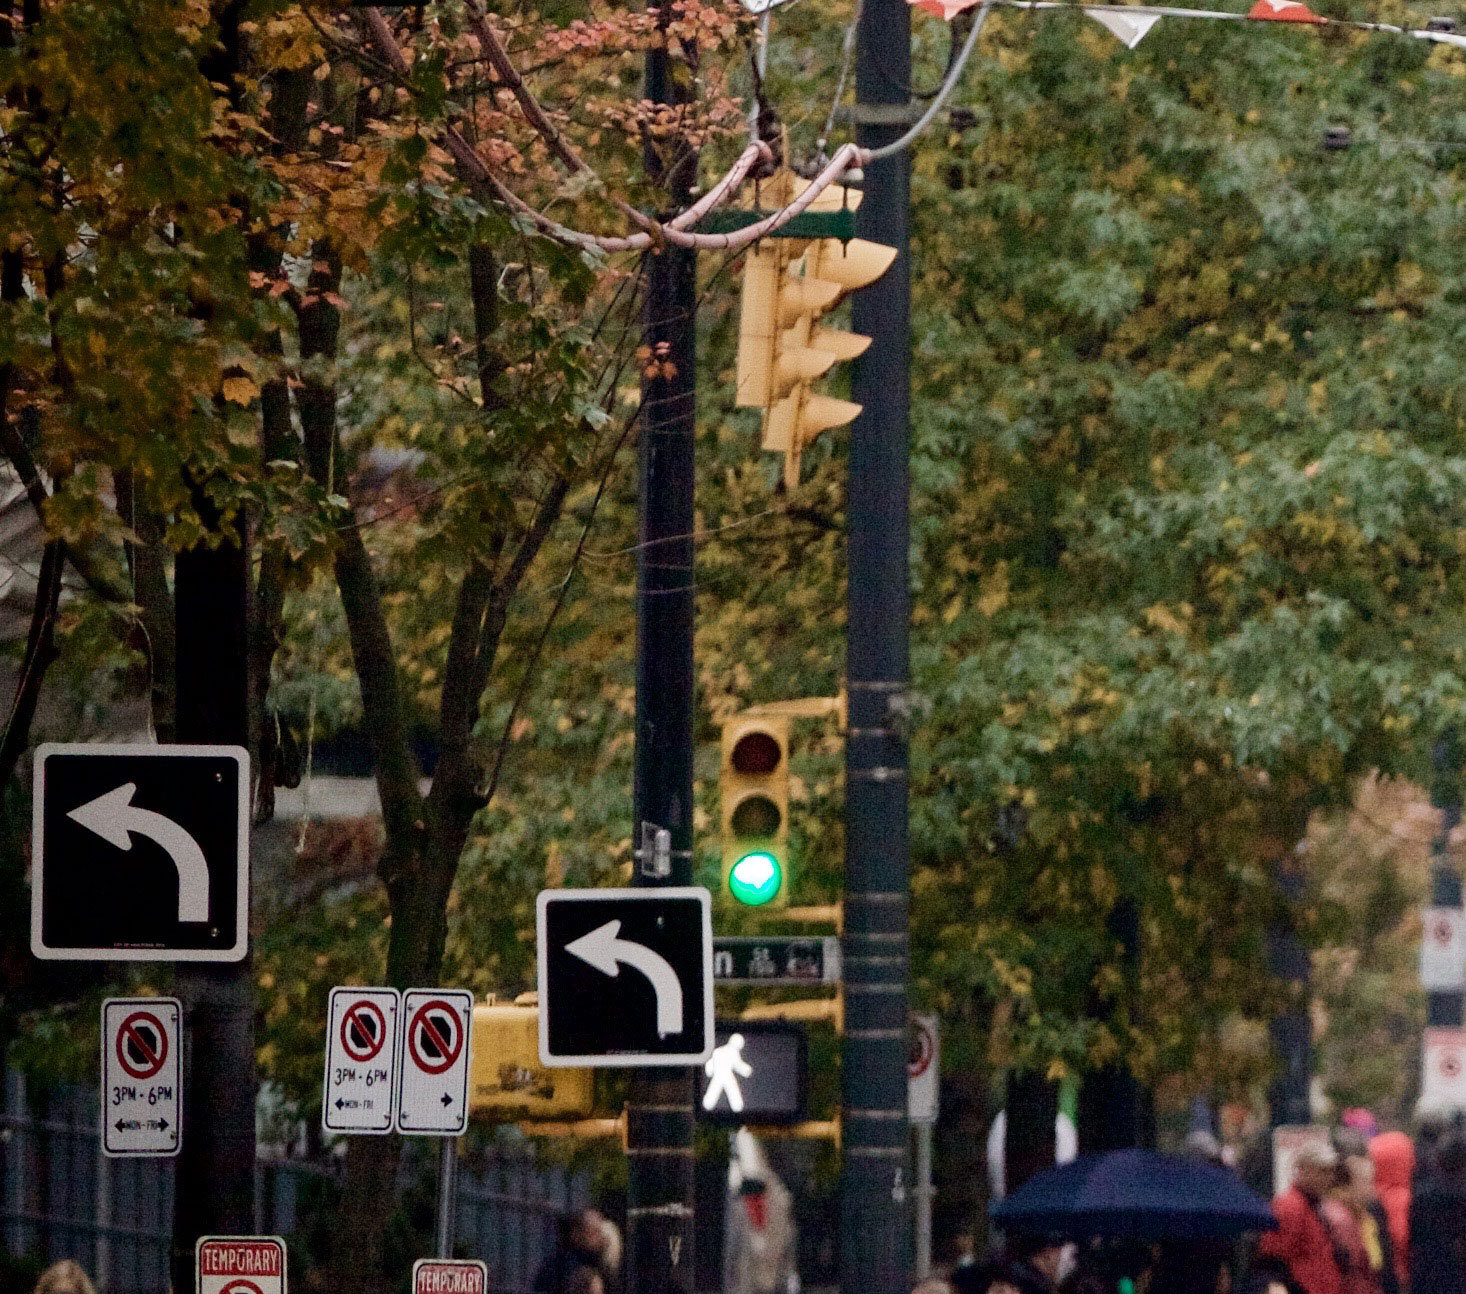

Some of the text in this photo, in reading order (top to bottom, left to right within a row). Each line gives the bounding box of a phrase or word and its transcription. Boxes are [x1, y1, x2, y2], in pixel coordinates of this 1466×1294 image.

[334, 1068, 356, 1086] 3PM
[365, 1069, 388, 1087] 6PM
[112, 1086, 136, 1106] 3PM
[148, 1086, 172, 1106] 6PM
[204, 1249, 278, 1272] TEMPORARY
[420, 1271, 481, 1293] TEMPORARY
